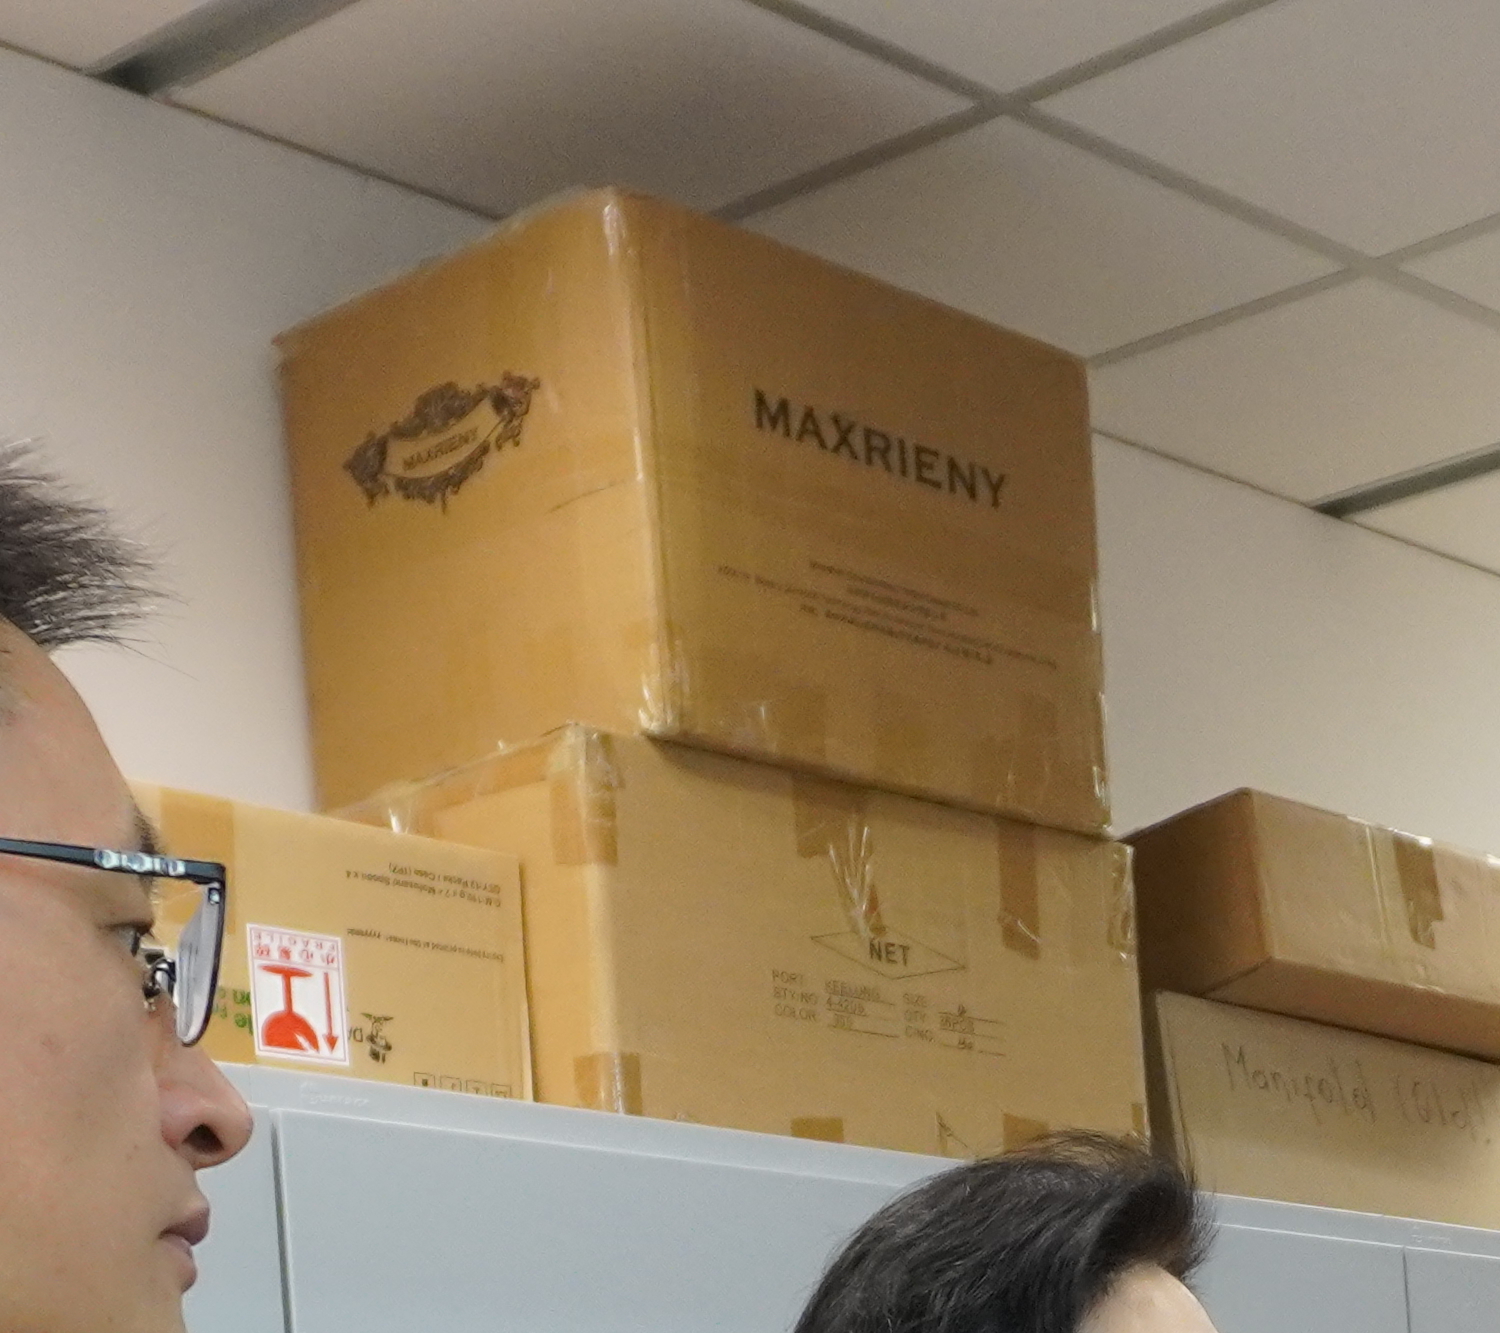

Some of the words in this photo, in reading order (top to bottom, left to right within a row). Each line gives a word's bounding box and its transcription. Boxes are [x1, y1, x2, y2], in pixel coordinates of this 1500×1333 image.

[754, 387, 1006, 509] MAXRIENY
[253, 931, 337, 953] FRAGILE
[868, 938, 911, 967] NET
